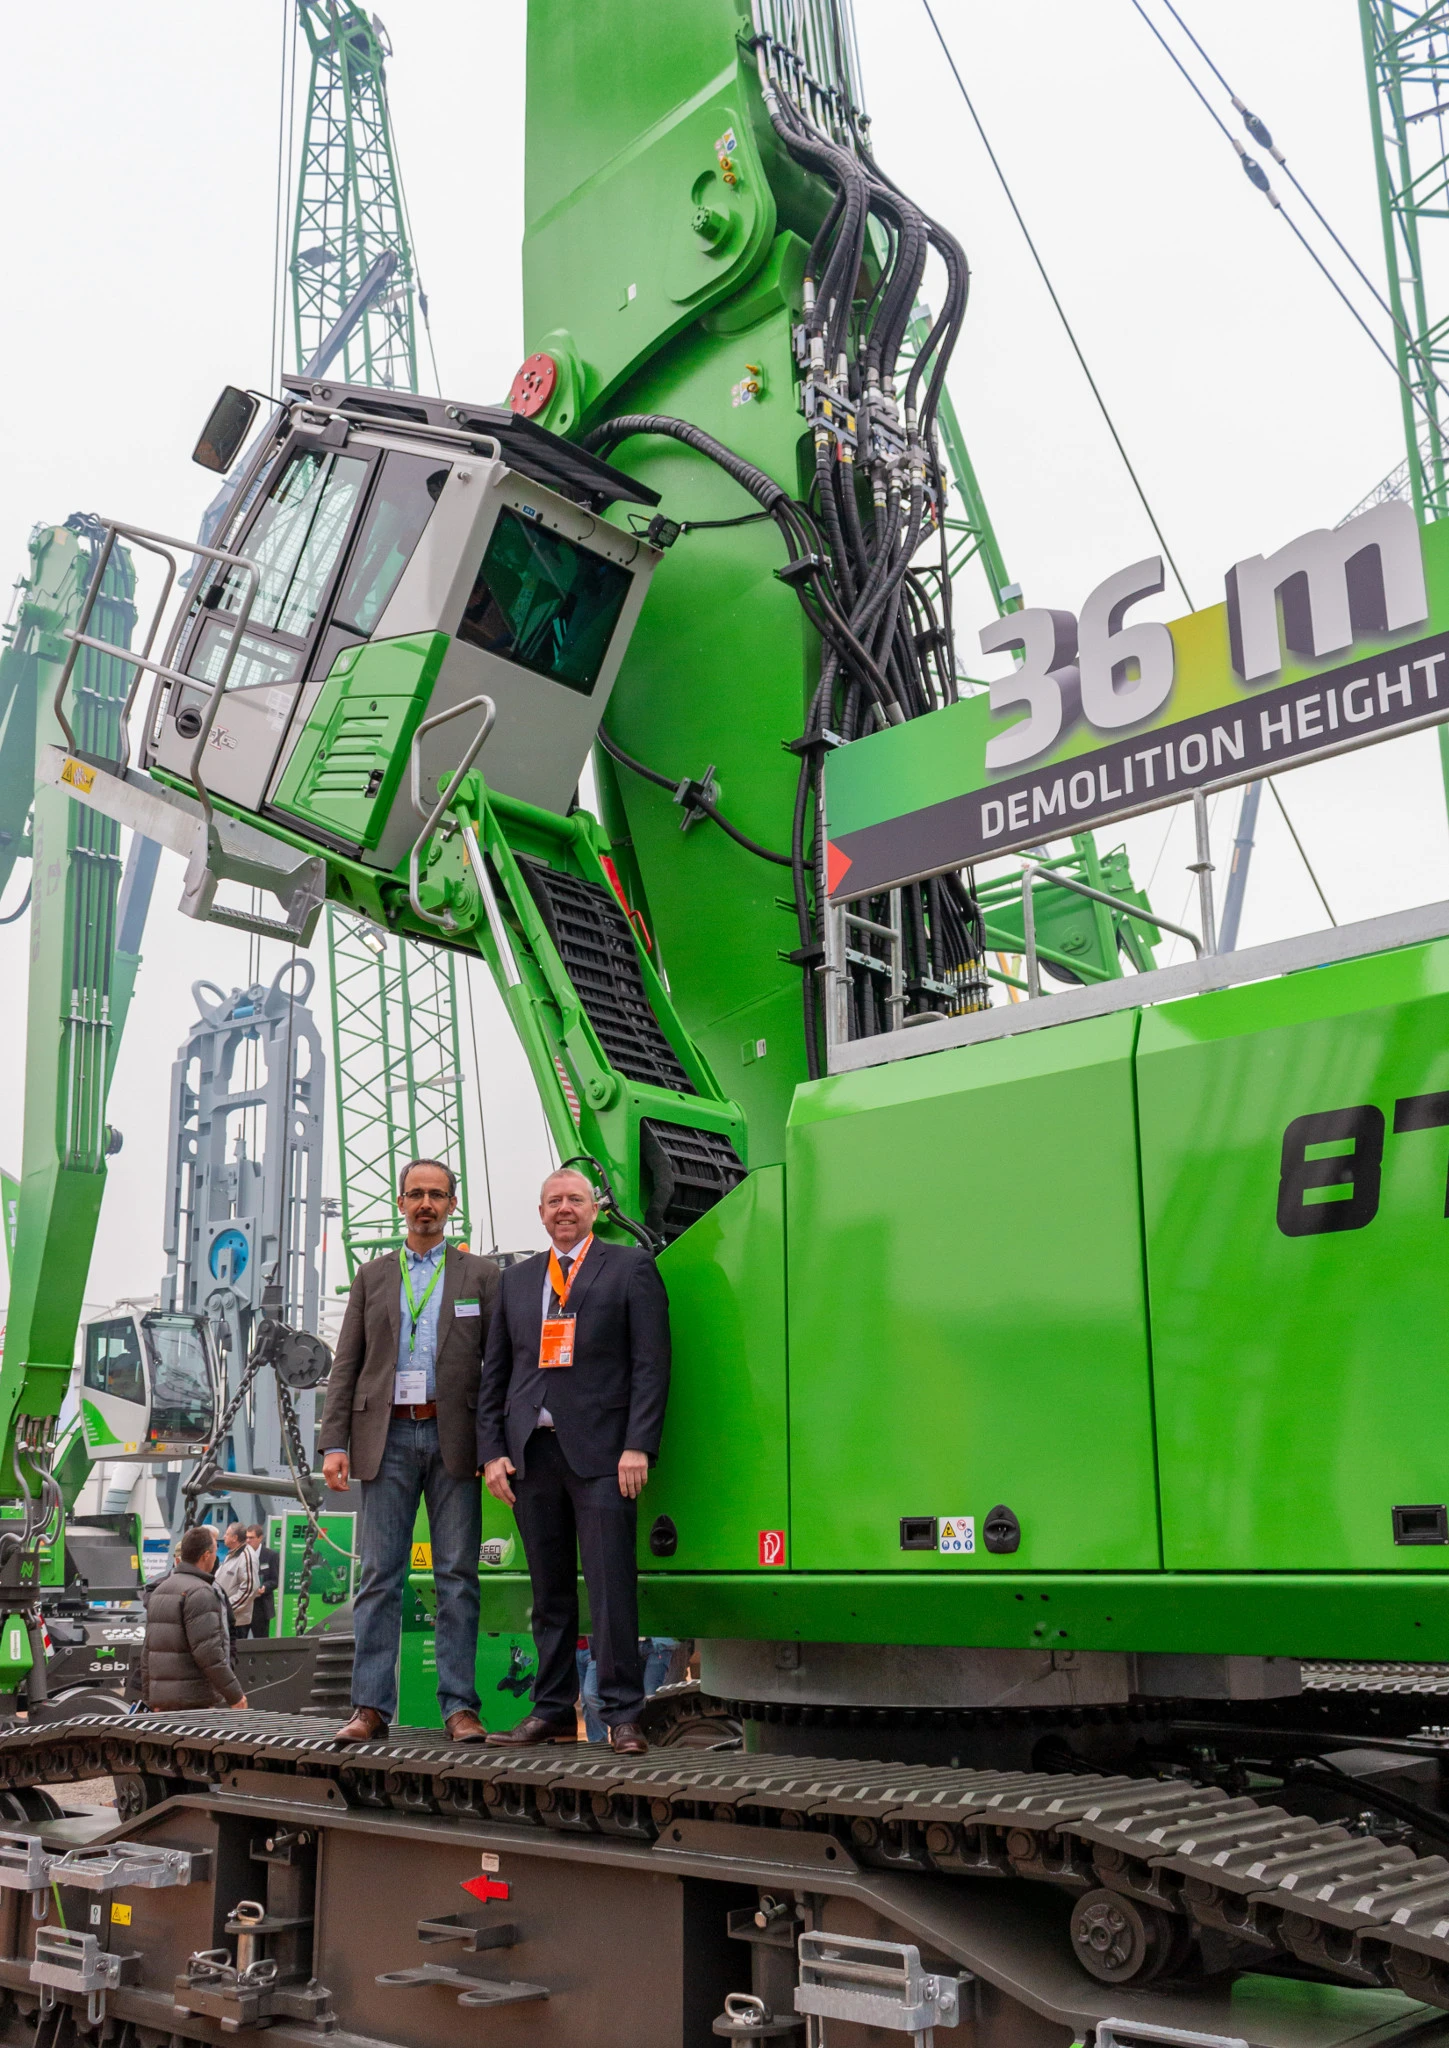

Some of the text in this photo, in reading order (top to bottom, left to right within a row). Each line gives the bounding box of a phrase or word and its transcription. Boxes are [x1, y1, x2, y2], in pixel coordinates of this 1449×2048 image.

[978, 499, 1429, 769] 36 m
[981, 652, 1446, 839] DEMOLITION HEIGHT
